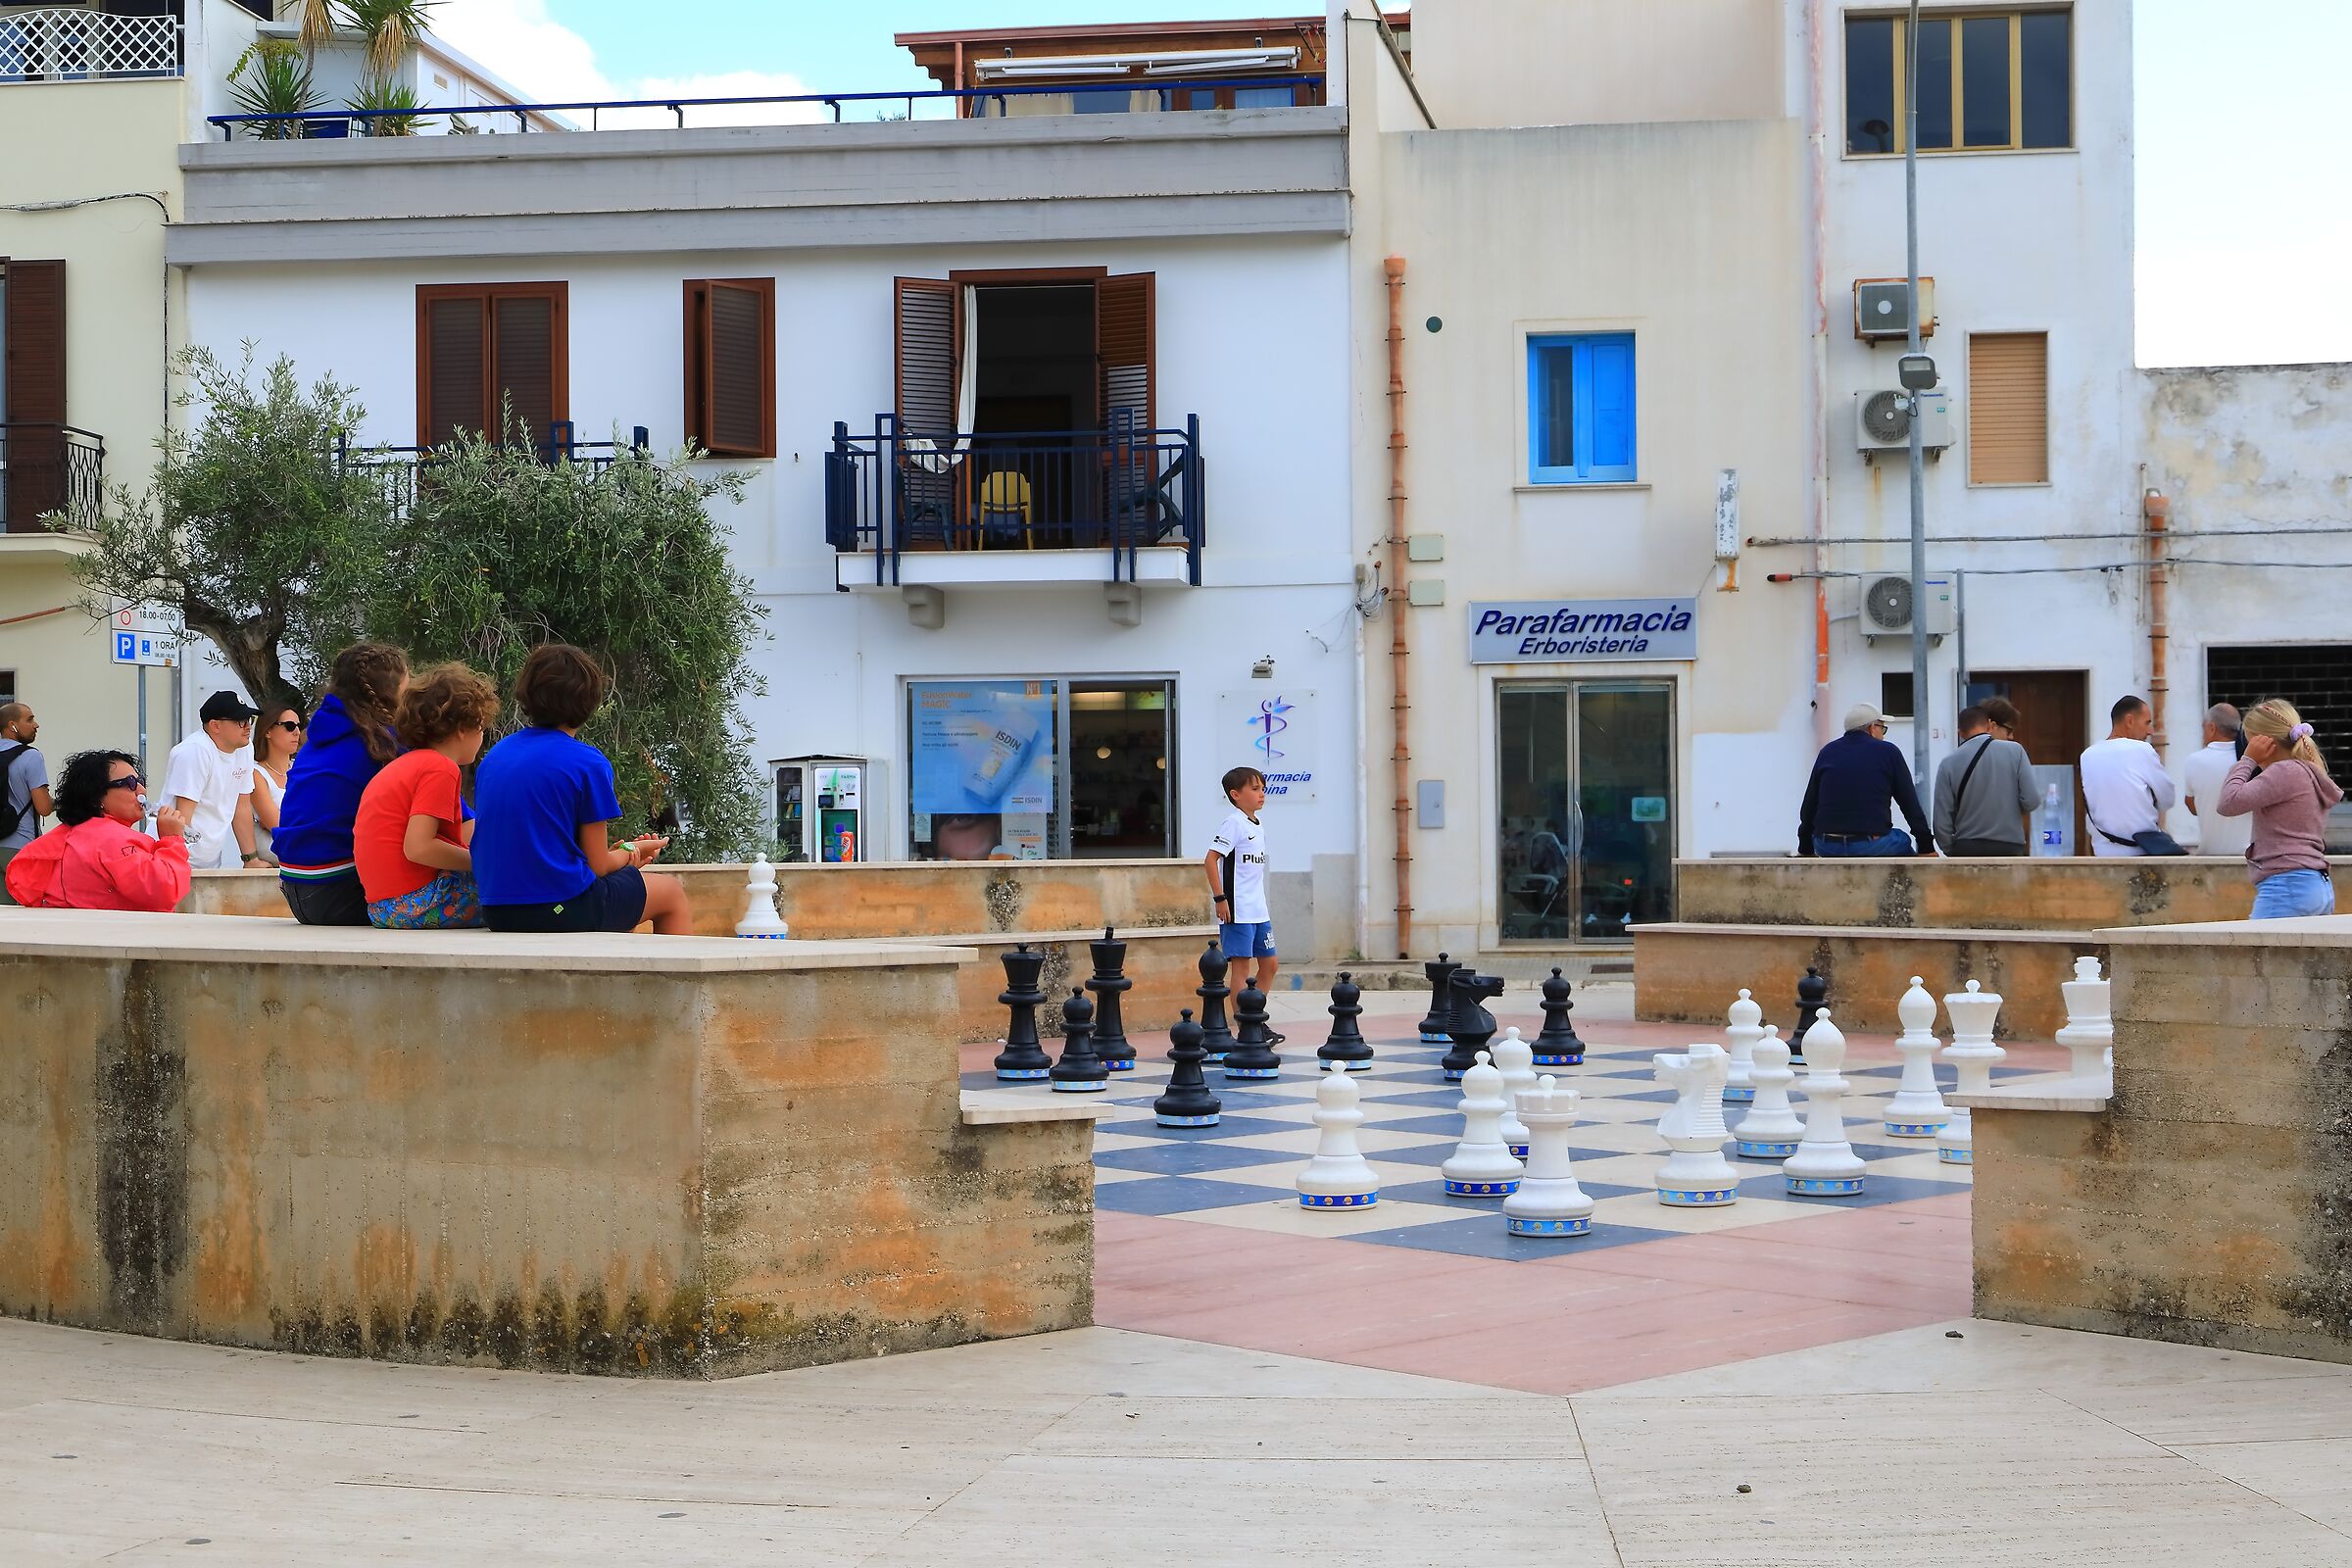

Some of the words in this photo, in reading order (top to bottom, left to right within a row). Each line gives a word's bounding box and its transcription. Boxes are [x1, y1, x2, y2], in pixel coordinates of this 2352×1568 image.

[1475, 605, 1691, 635] Parafarmacia
[122, 637, 131, 656] P
[160, 641, 175, 650] ORA
[1518, 635, 1648, 655] Erboristeria
[995, 730, 1021, 751] ISDIN
[1262, 770, 1311, 782] armacia
